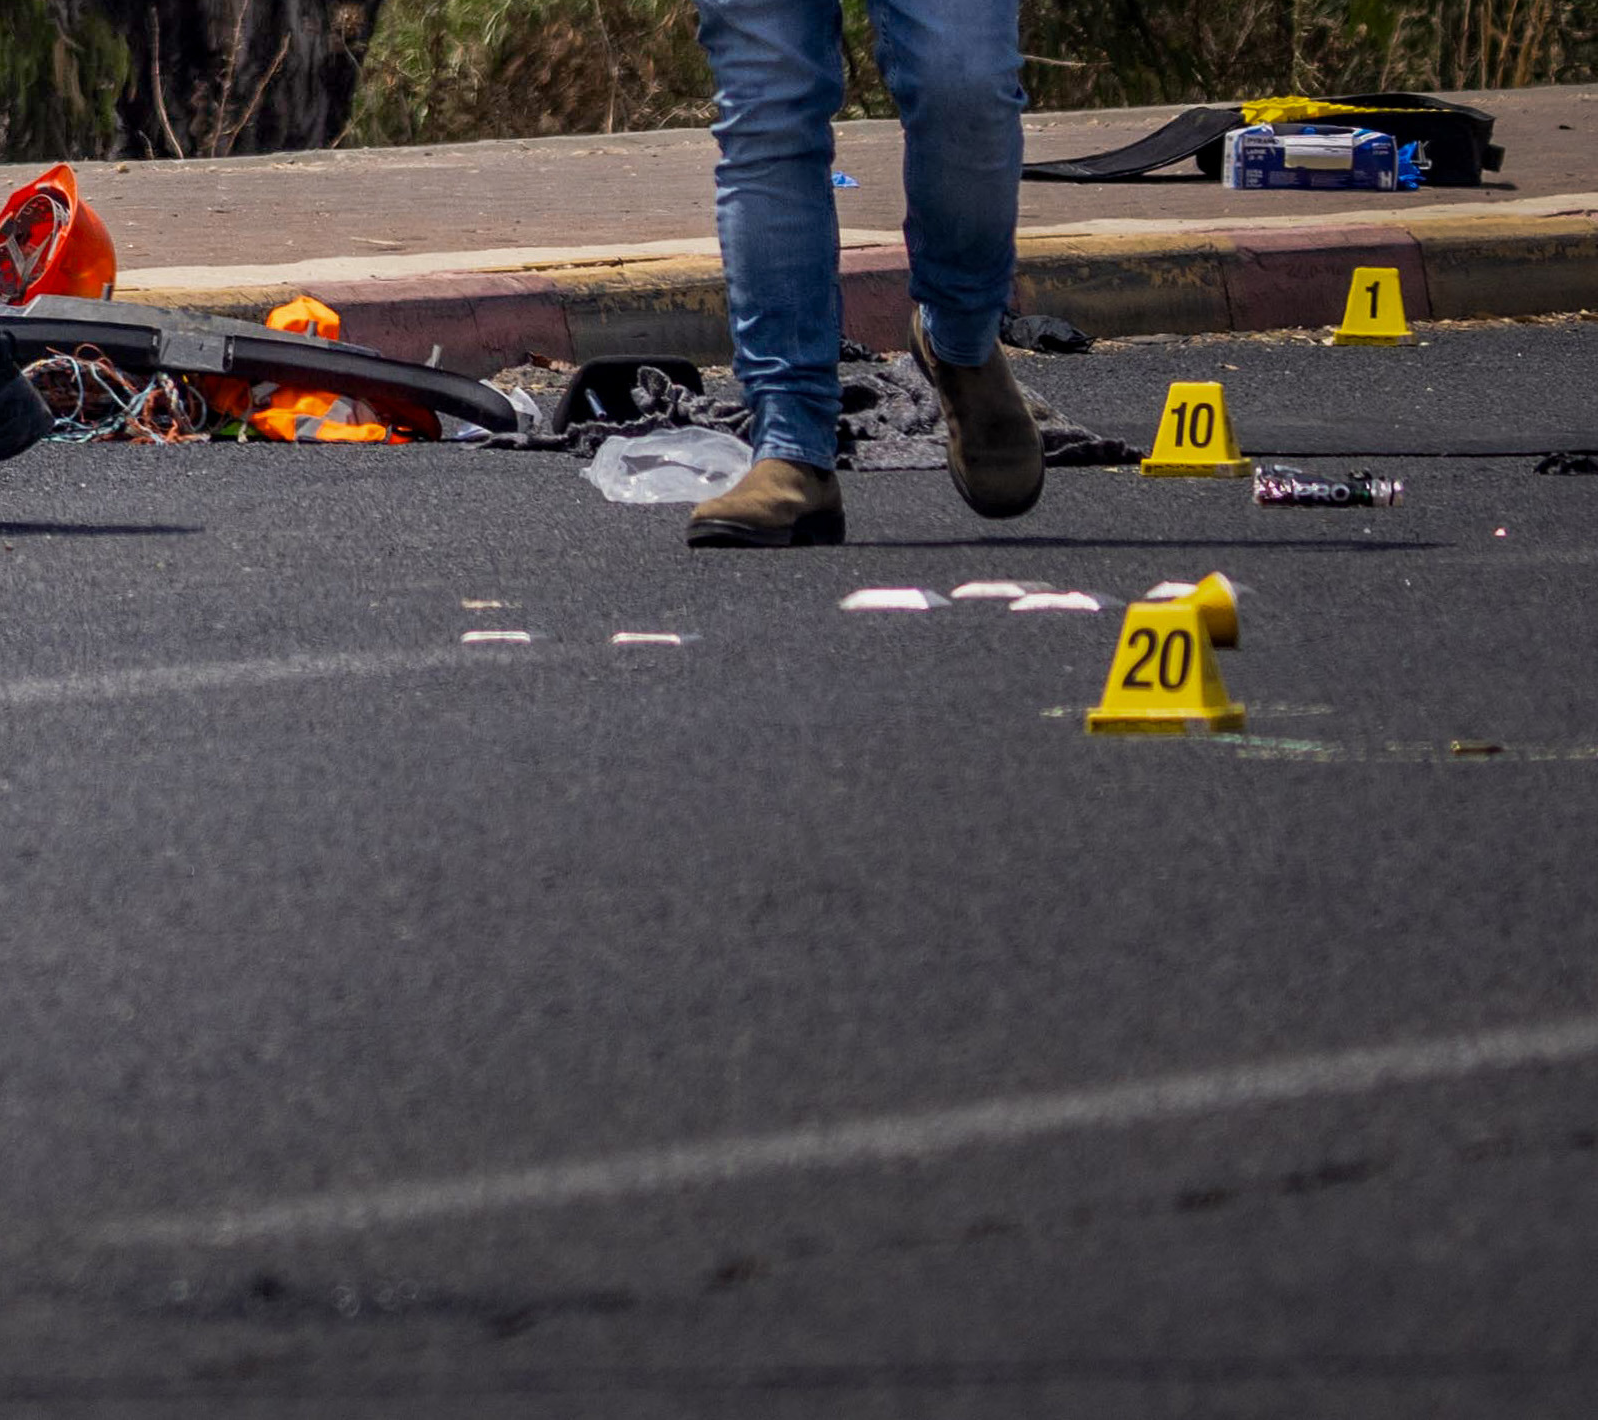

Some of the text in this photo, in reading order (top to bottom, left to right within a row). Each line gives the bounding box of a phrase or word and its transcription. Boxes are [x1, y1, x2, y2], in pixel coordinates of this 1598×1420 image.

[1364, 280, 1382, 320] 1
[1171, 401, 1215, 449] 10
[1293, 483, 1350, 501] PRO
[1122, 626, 1193, 691] 20
